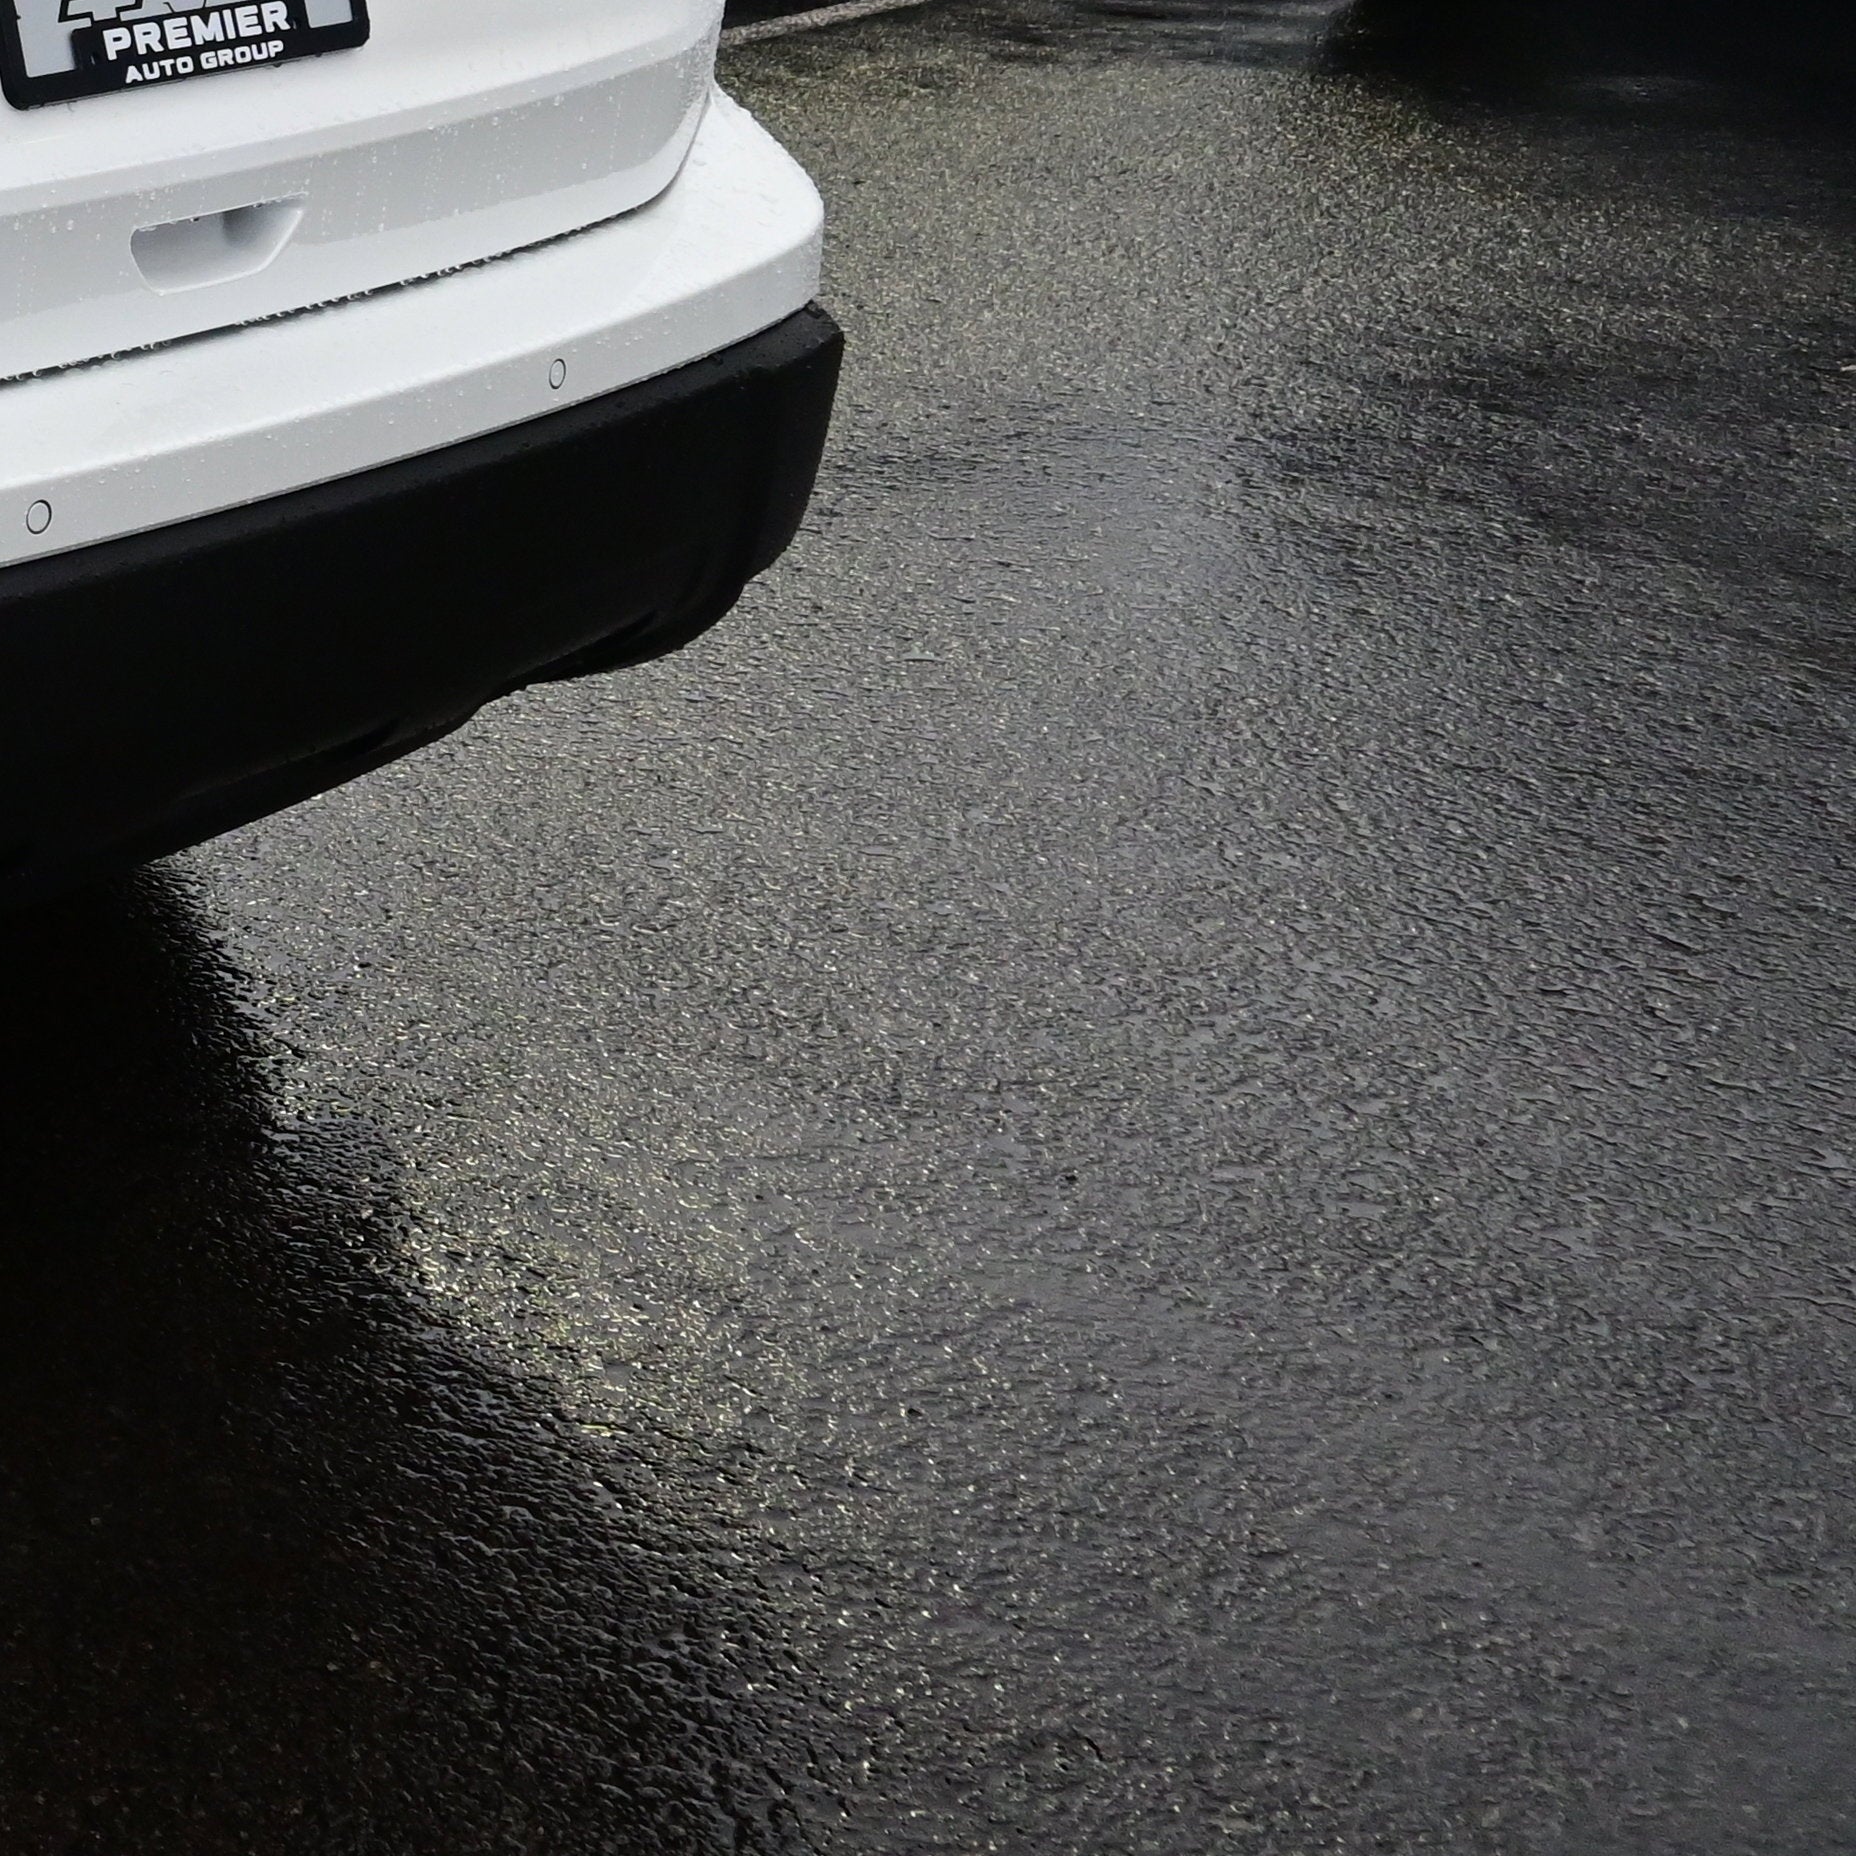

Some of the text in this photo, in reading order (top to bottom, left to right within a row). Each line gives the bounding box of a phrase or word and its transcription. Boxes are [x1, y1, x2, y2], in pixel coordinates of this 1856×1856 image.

[102, 0, 292, 62] PREMIER
[125, 40, 285, 84] AUTO GROUP
